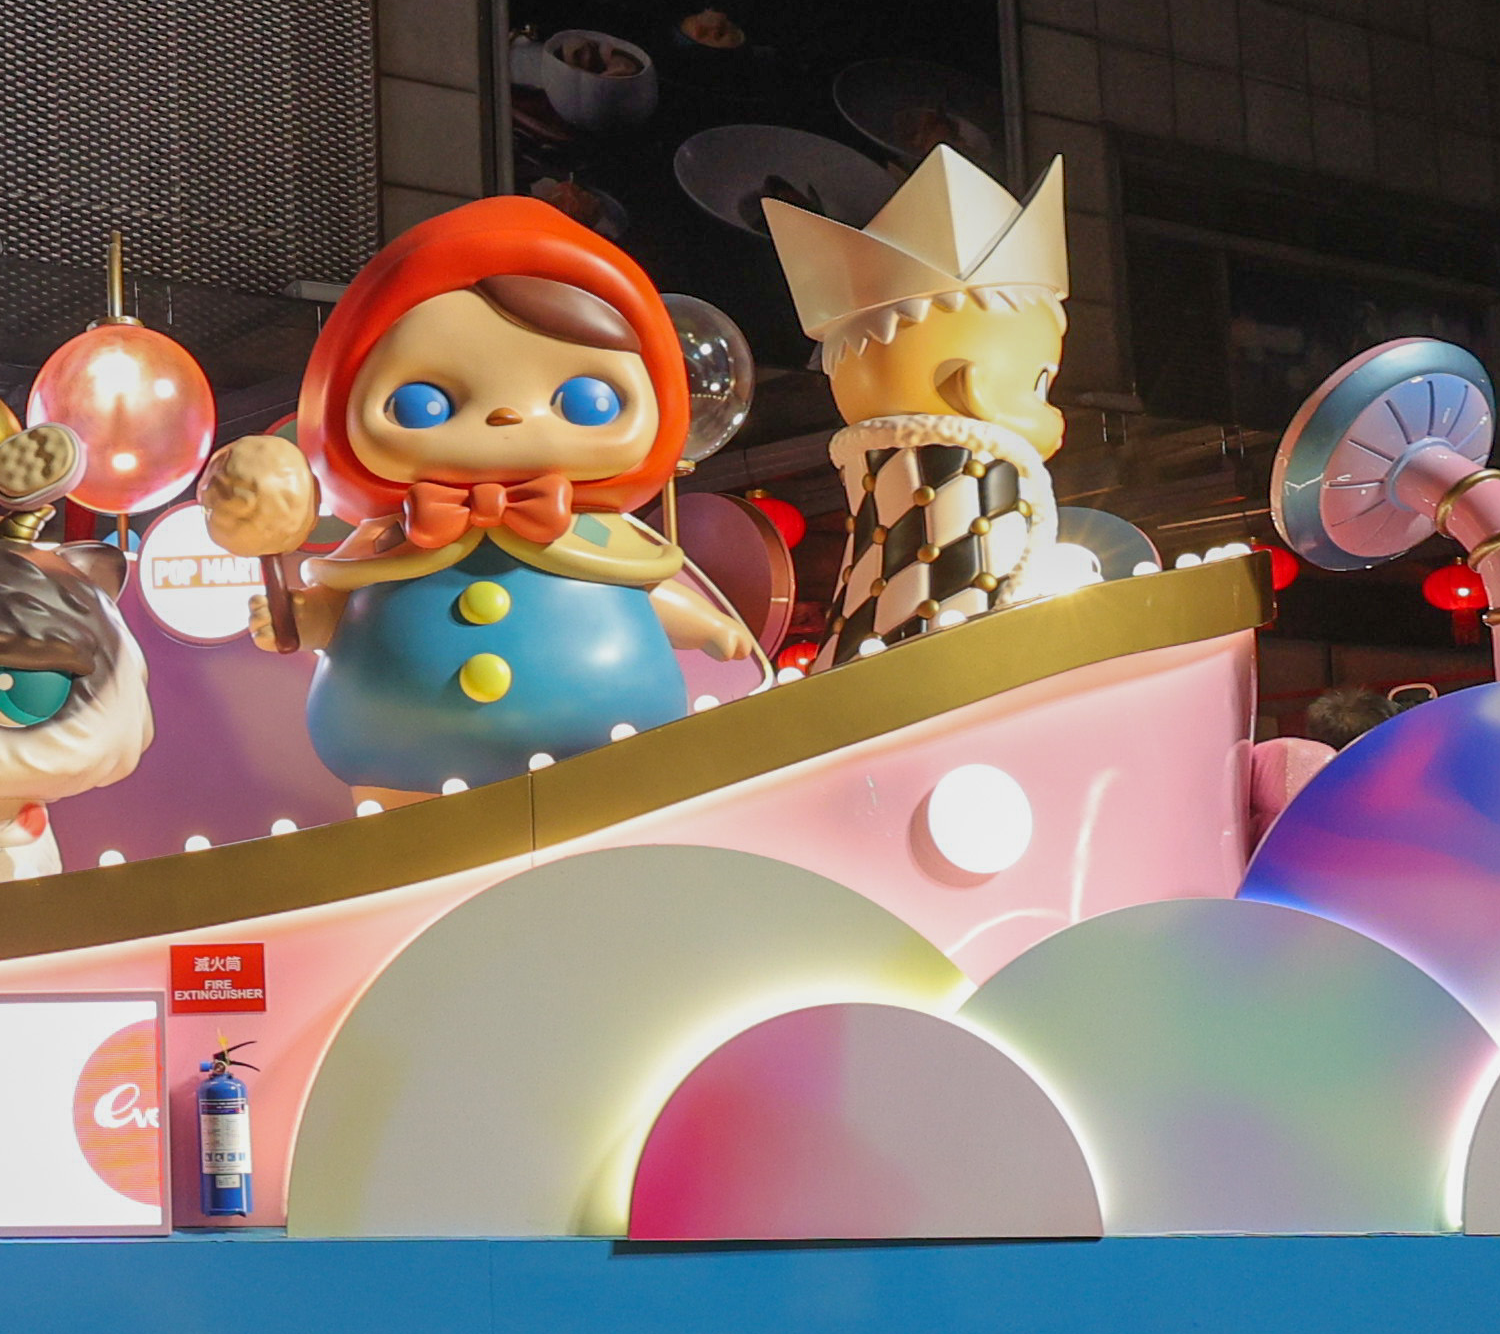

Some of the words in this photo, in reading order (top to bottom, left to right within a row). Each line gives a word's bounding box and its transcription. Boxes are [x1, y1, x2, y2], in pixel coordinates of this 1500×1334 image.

[153, 558, 198, 586] POP
[201, 556, 262, 584] MART
[193, 956, 242, 972] 滅火筒
[204, 979, 232, 990] FIRE
[174, 988, 264, 1001] EXTINGUISHER
